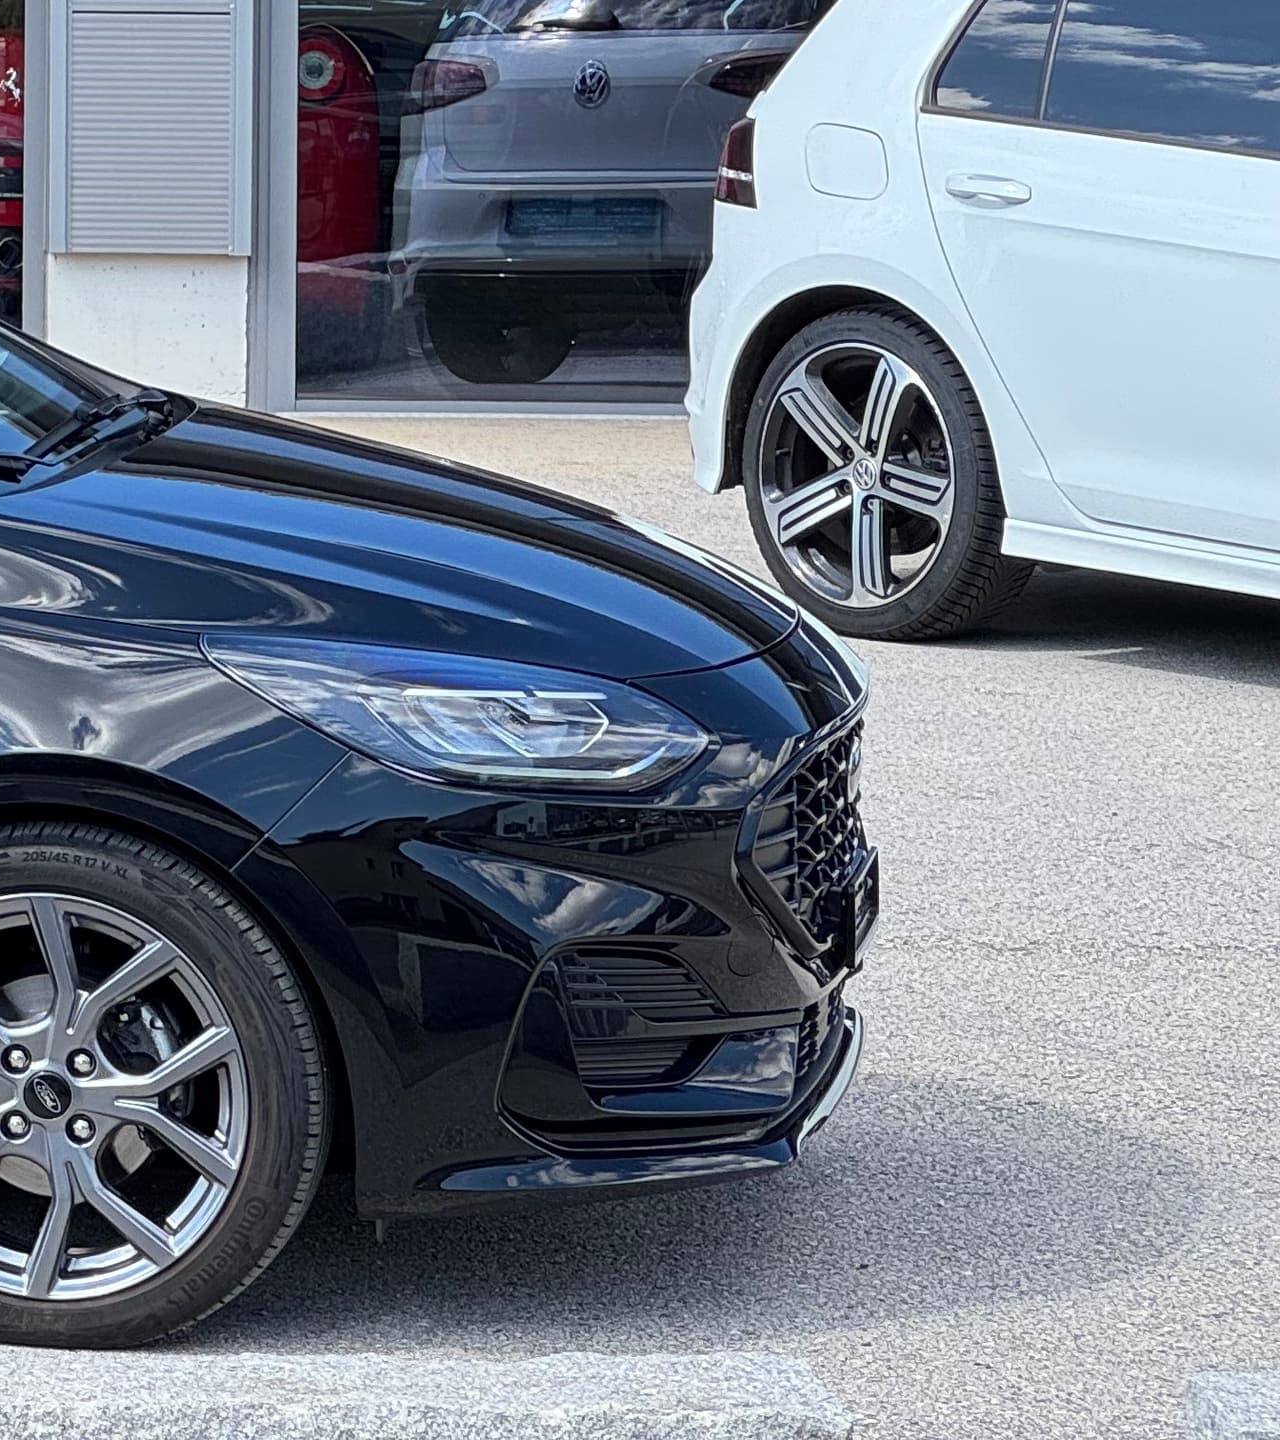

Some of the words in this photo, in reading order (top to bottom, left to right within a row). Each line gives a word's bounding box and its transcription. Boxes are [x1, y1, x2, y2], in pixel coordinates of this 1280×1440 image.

[23, 850, 70, 864] 205/45
[101, 860, 111, 872] V
[112, 864, 129, 880] XL
[180, 1196, 268, 1300] Continental
